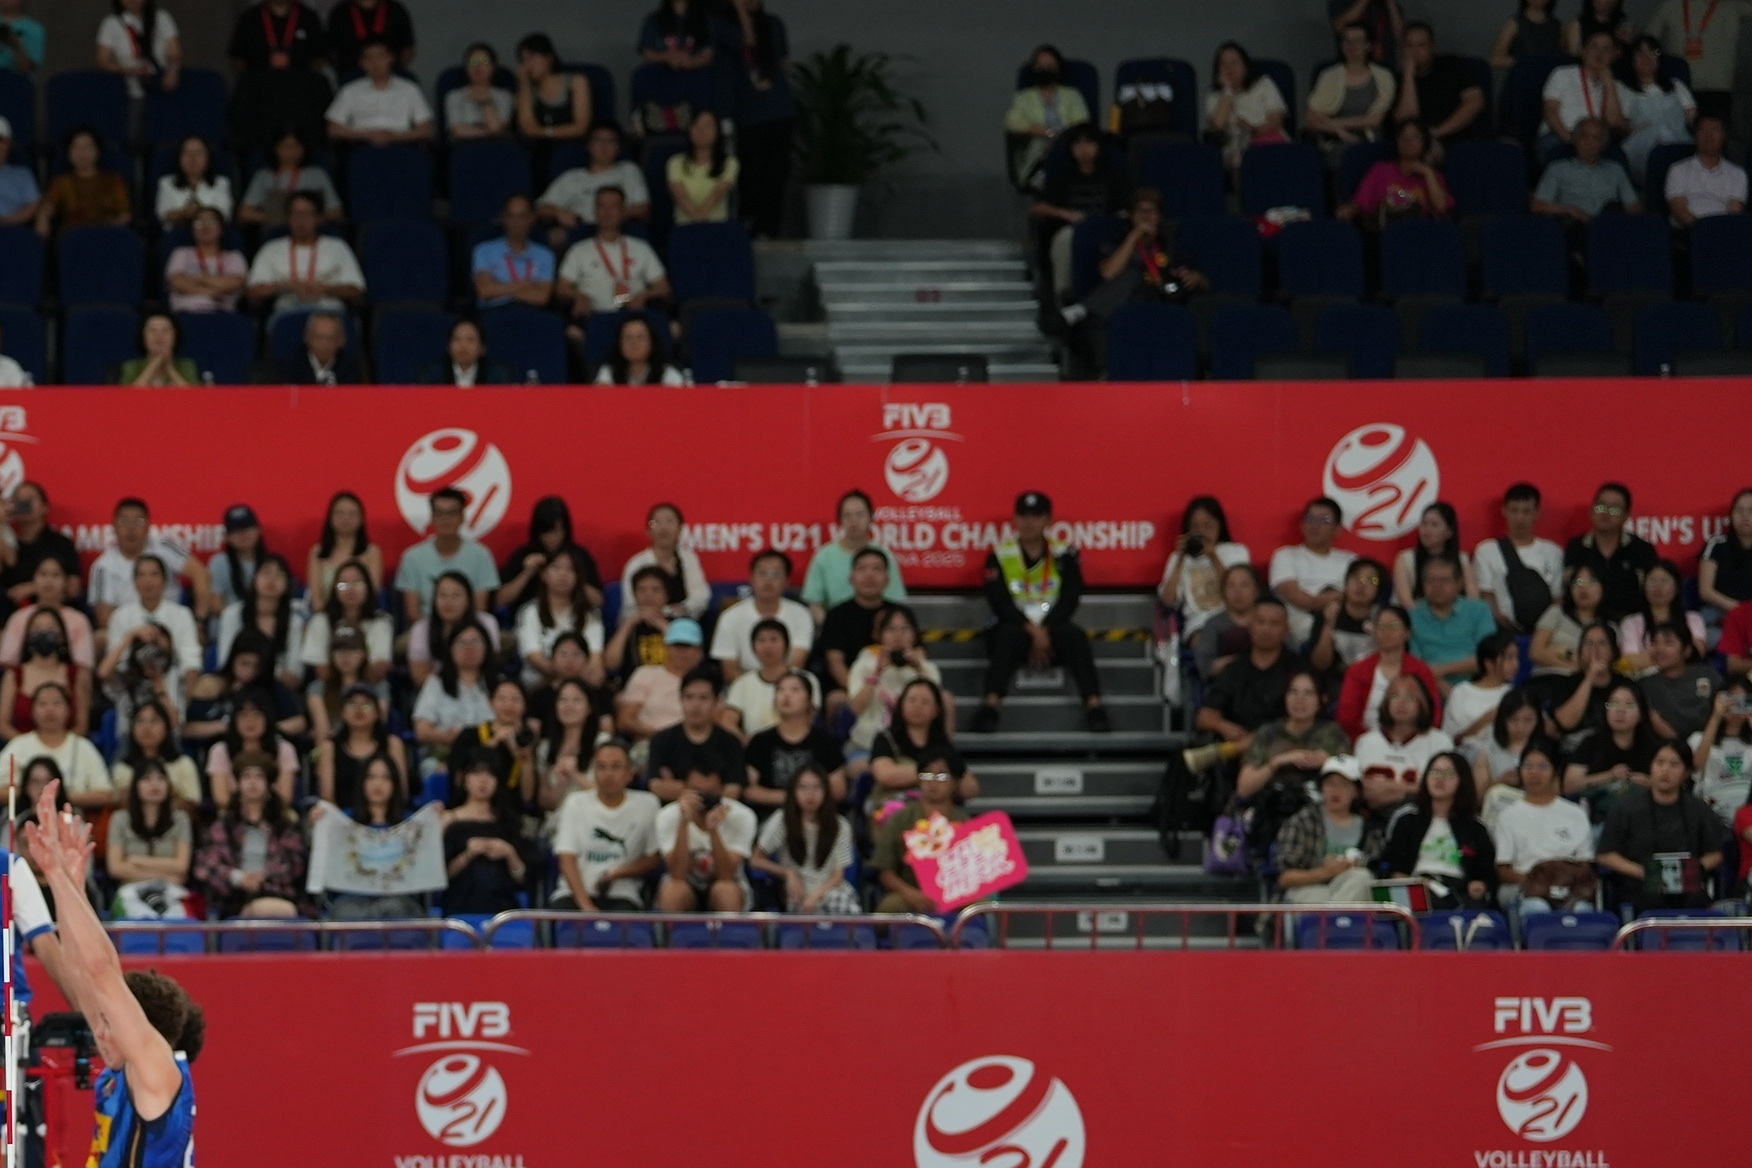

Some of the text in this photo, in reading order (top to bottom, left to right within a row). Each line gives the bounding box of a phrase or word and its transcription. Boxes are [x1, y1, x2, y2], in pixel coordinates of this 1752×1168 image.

[883, 402, 951, 430] FIVB
[768, 524, 822, 551] U21
[413, 1001, 511, 1038] FIVB
[1494, 997, 1592, 1034] FIVB
